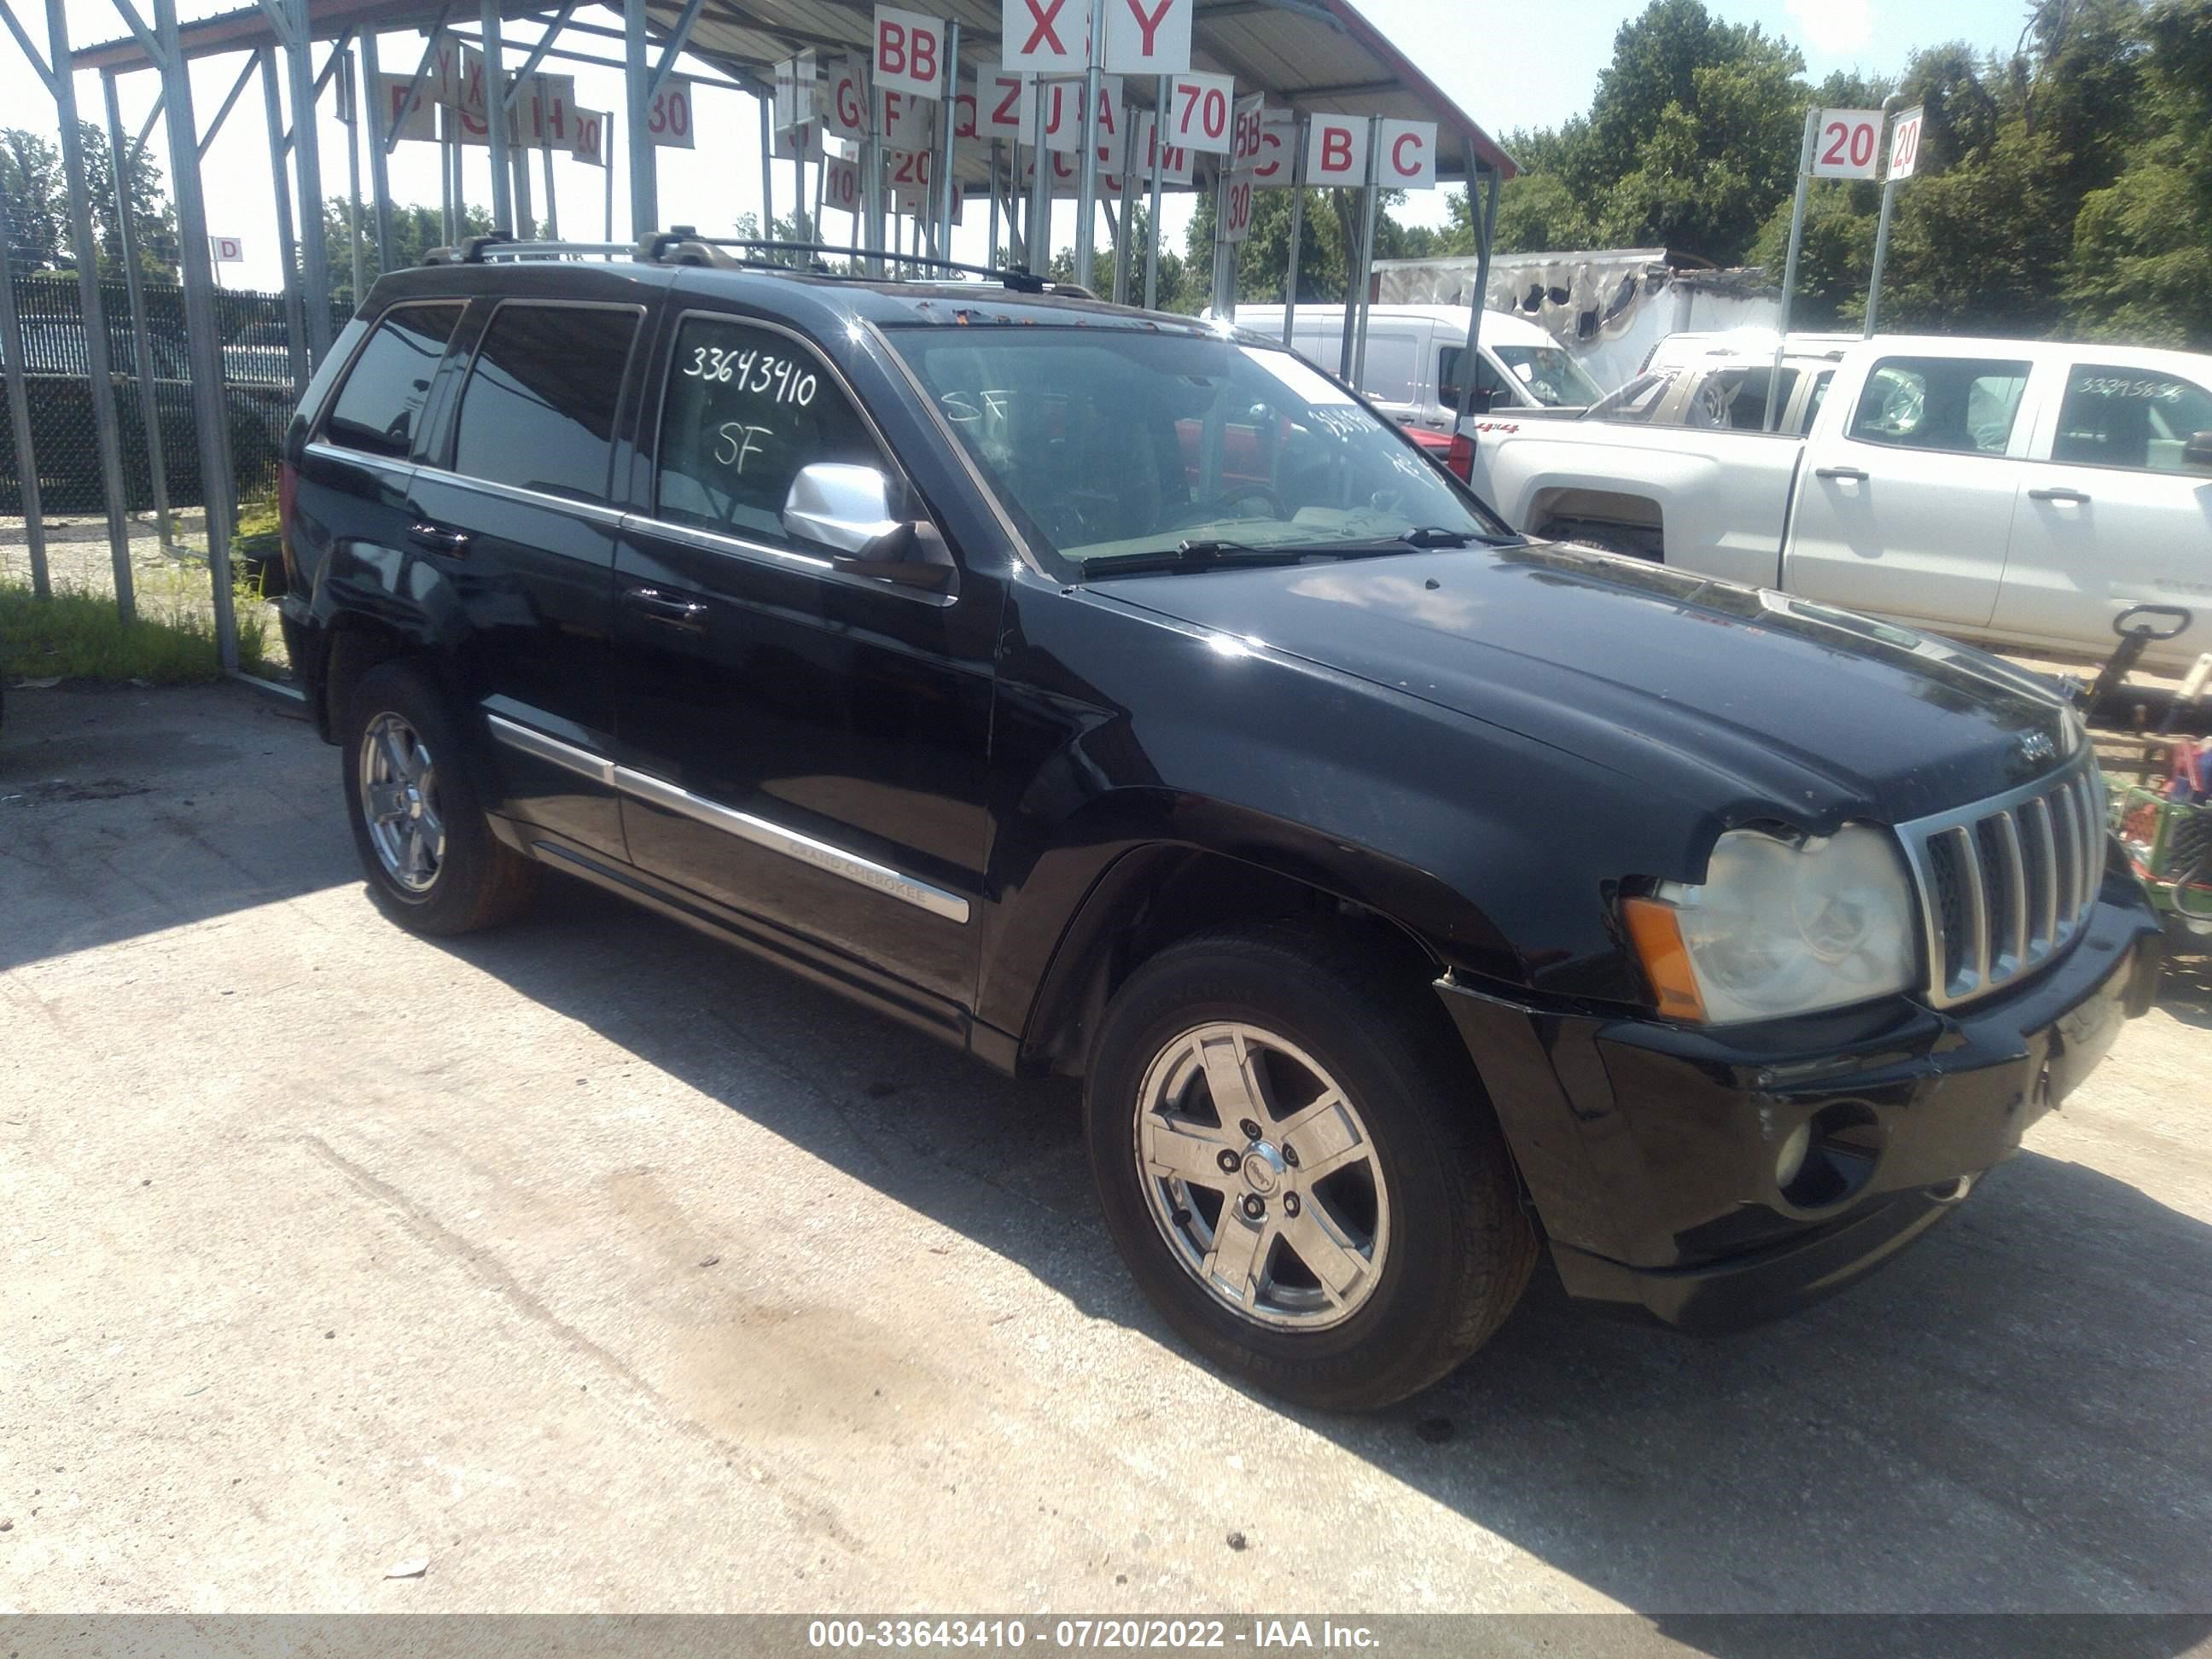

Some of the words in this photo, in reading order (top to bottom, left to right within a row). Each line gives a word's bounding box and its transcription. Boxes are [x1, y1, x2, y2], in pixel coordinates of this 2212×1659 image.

[879, 20, 937, 82] BB
[1020, 0, 1067, 55] X
[1125, 0, 1175, 56] Y
[648, 91, 687, 137] 30
[836, 78, 860, 129] G
[991, 78, 1022, 125] Z
[1177, 84, 1226, 138] 70
[1234, 110, 1260, 159] BB
[1321, 126, 1353, 172] B
[1392, 132, 1423, 177] C
[1820, 121, 1874, 167] 20
[1893, 120, 1917, 168] 20
[830, 166, 854, 204] 10
[1229, 182, 1250, 230] 30
[221, 240, 236, 259] D
[683, 346, 817, 406] 33643410
[940, 389, 1018, 422] SF
[714, 422, 774, 474] SF
[845, 863, 927, 903] CHEROKEE
